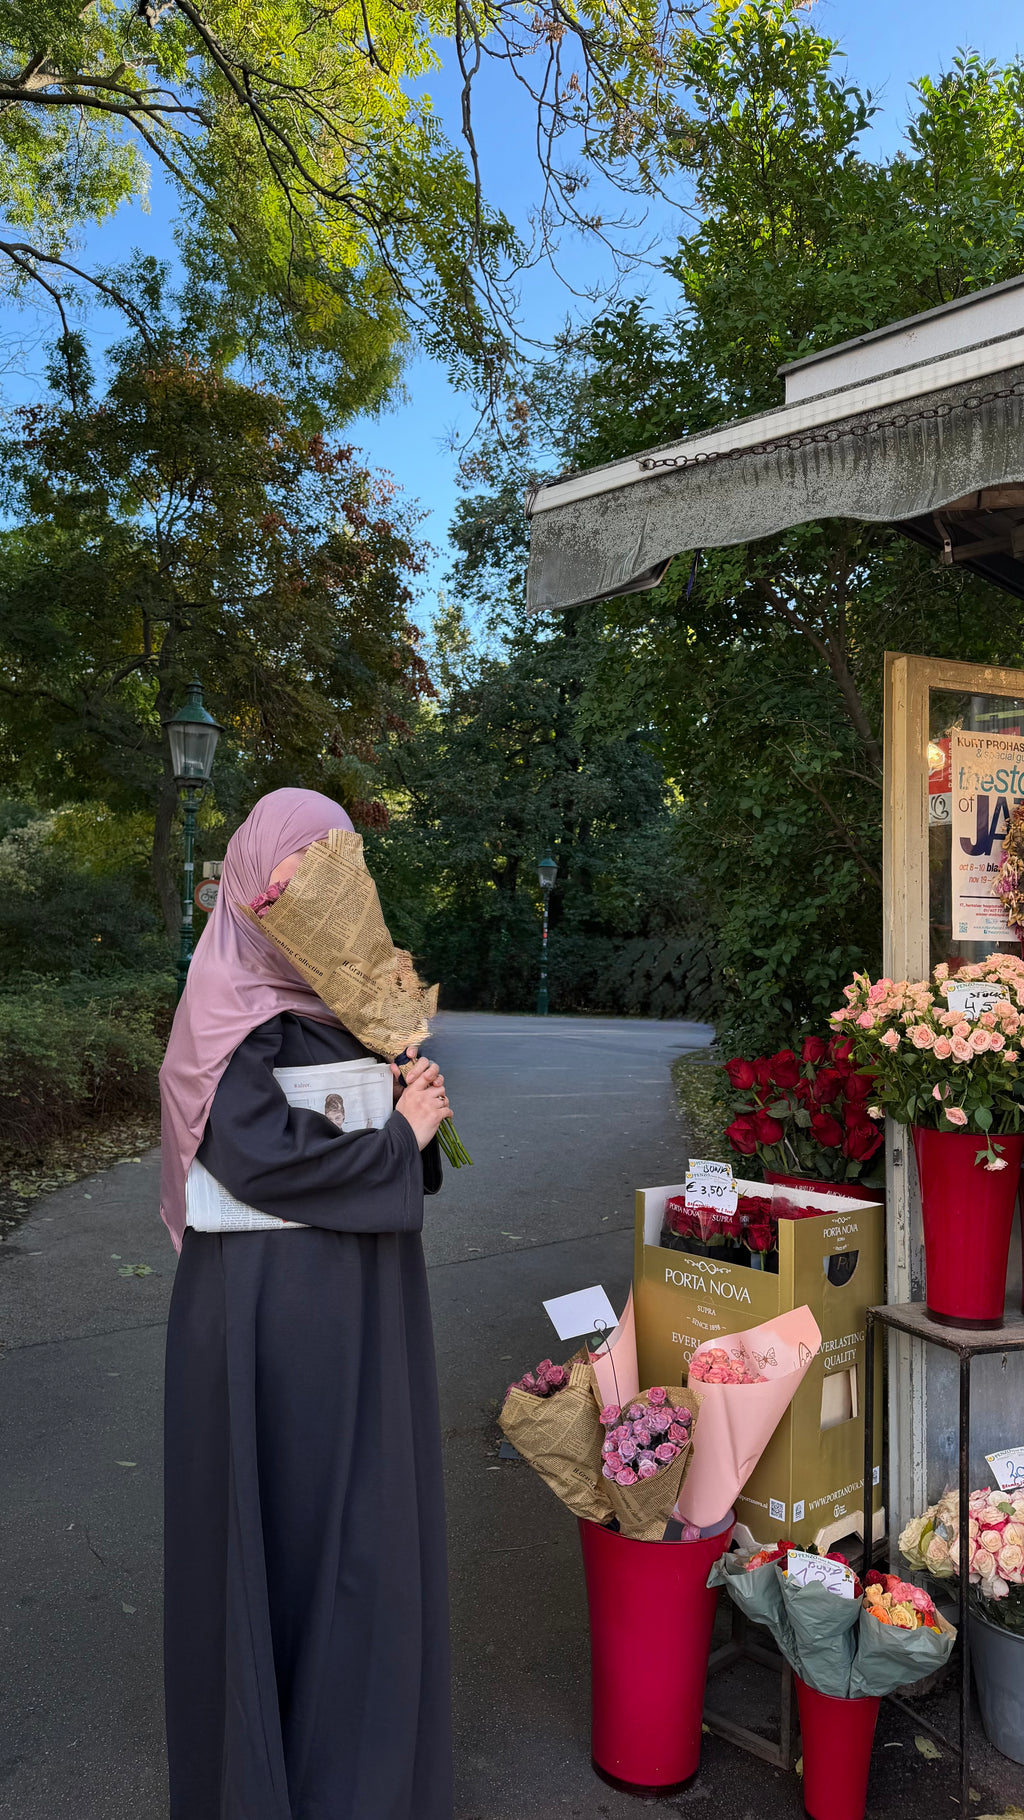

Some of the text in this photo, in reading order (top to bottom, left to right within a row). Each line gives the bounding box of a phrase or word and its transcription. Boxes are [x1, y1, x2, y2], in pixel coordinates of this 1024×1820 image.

[957, 736, 984, 749] KURT
[958, 792, 975, 813] of
[959, 794, 1024, 857] JA
[294, 952, 324, 978] Collection
[685, 1181, 698, 1193] €
[682, 1207, 701, 1218] NOVA
[711, 1213, 733, 1224] SUPRA
[823, 1226, 842, 1239] PORTA
[842, 1223, 859, 1235] NOVA
[665, 1268, 752, 1305] PORTA NOVA
[697, 1304, 717, 1317] SUPRA
[816, 1330, 865, 1355] VERLASTING
[823, 1348, 857, 1370] QUALITY
